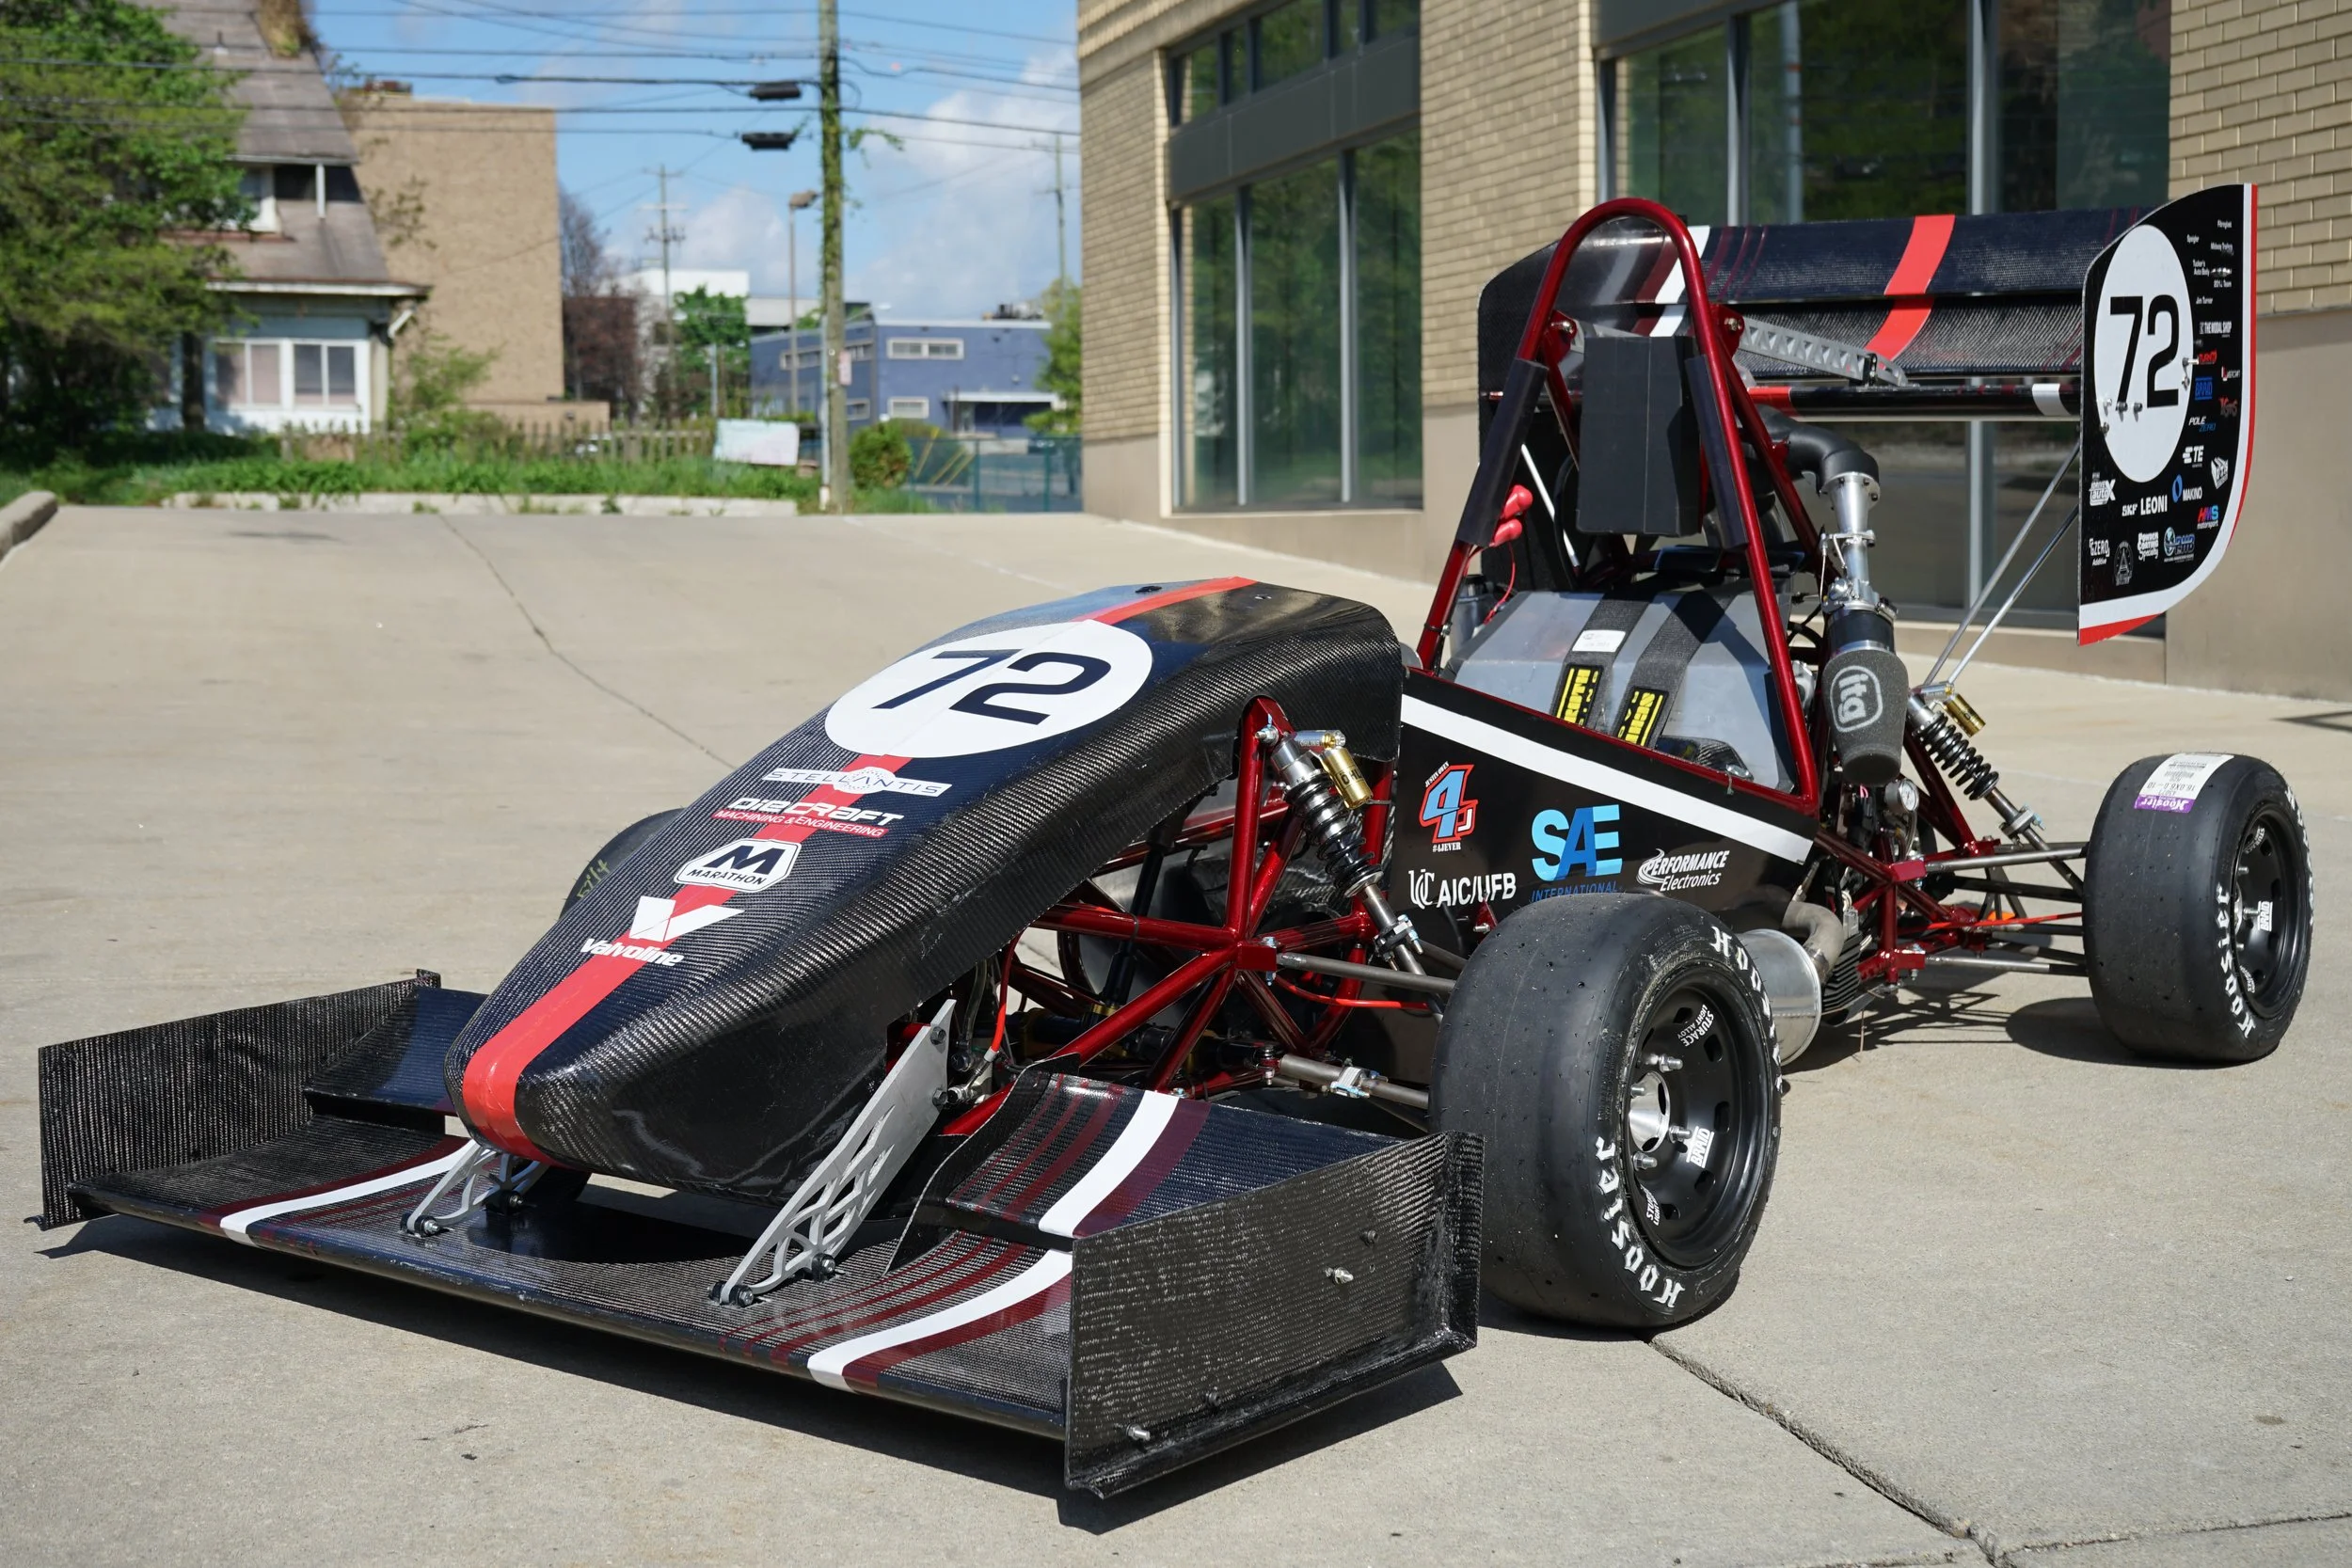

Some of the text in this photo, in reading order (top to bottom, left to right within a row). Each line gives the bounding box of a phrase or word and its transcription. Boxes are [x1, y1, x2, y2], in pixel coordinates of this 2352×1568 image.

[2110, 294, 2179, 410] 72
[2188, 417, 2207, 426] POLE
[2140, 495, 2168, 515] LEONI
[2183, 487, 2202, 501] MAKINO
[2122, 503, 2137, 516] SKF
[871, 648, 1111, 725] 72
[769, 770, 942, 795] STELLANTIS
[715, 810, 885, 837] MACHINING & ENGINEERING
[1532, 804, 1622, 881] SAE
[686, 868, 767, 886] MARATHON
[1646, 850, 1730, 877] PERFORMANCE
[1437, 872, 1517, 909] AIC/UFB
[1531, 880, 1619, 903] INTERNATIONAL
[1660, 869, 1721, 892] Electronics
[580, 938, 685, 967] Valvoline
[1677, 1004, 1708, 1039] LIGHT ALLOY
[1680, 1010, 1714, 1047] STURACE
[1690, 1128, 1711, 1167] BRAID
[1596, 1136, 1686, 1309] HOOSIER
